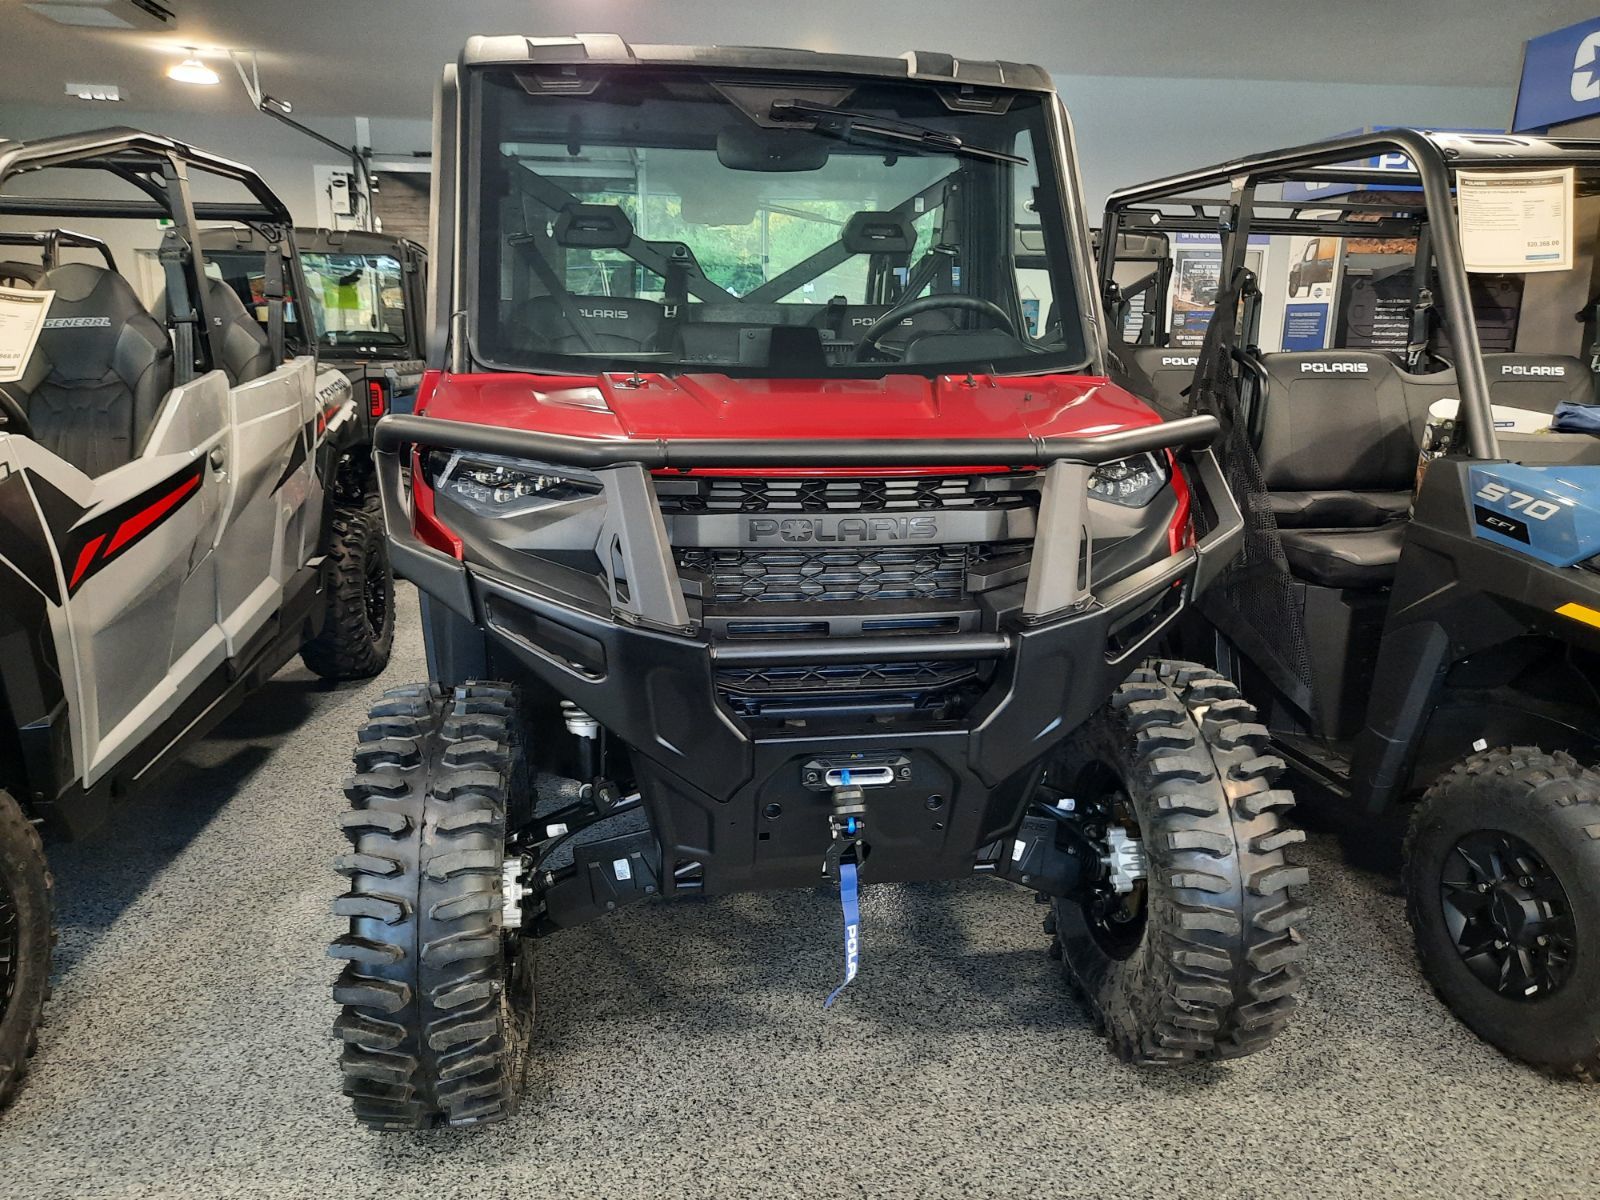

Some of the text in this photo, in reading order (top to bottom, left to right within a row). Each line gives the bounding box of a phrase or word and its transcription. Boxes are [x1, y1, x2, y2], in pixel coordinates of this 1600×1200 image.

[563, 309, 629, 319] LARIS
[44, 316, 112, 329] GENERAL
[1162, 357, 1199, 366] POLA
[1300, 362, 1369, 373] POLARIS
[1501, 365, 1566, 376] POLARIS
[1475, 482, 1561, 521] 570
[748, 516, 938, 543] POLARIS
[1485, 516, 1517, 532] EFI
[846, 924, 858, 981] POLA
